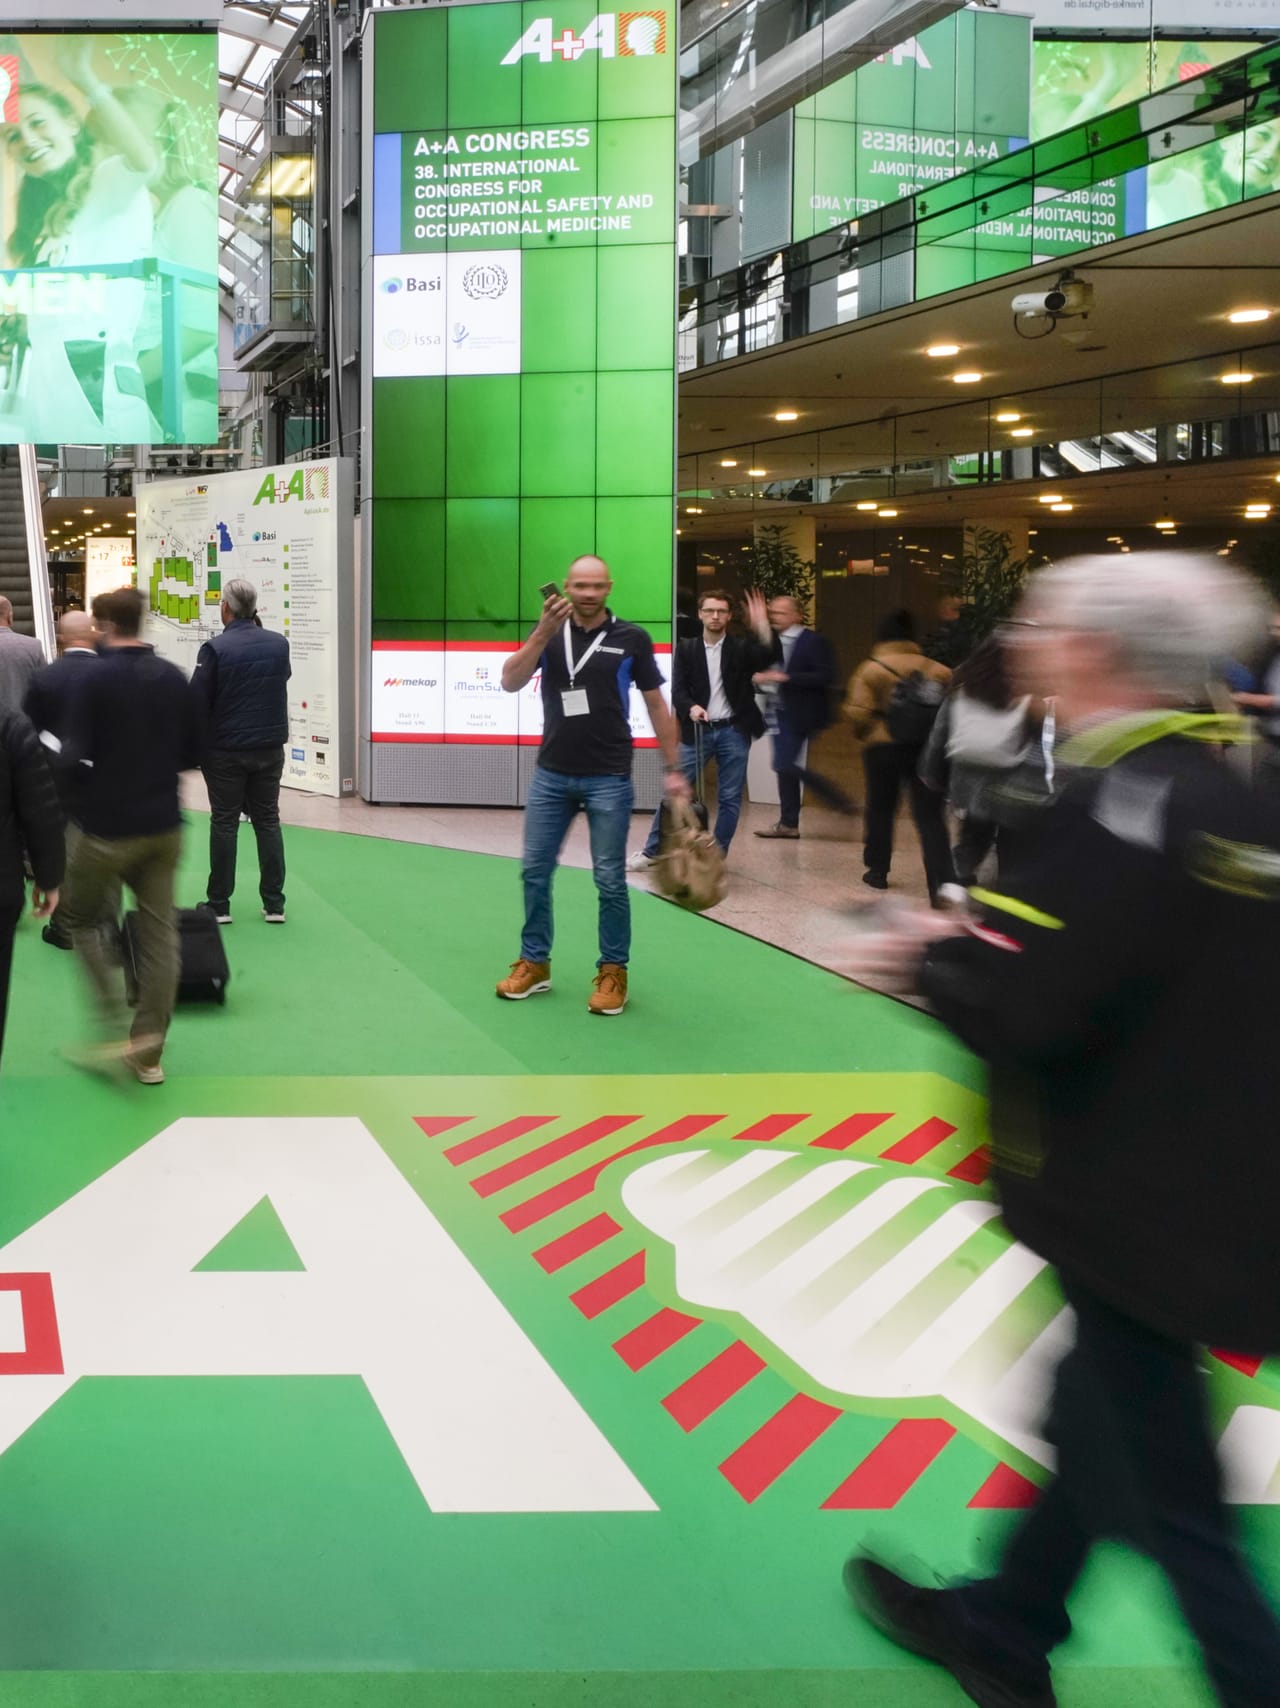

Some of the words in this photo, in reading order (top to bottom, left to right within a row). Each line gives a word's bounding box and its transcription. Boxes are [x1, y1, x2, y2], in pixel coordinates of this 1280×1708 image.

[500, 13, 616, 65] A+A
[414, 136, 460, 156] A+A
[465, 128, 591, 153] CONGRESS
[414, 165, 439, 180] 38.
[443, 157, 580, 178] INTERNATIONAL
[414, 182, 504, 200] CONGRESS
[508, 179, 543, 195] FOR
[414, 200, 543, 219] OCCUPATIONAL
[546, 195, 613, 213] SAFETY
[616, 194, 654, 210] AND
[414, 220, 543, 239] OCCUPATIONAL
[546, 215, 632, 234] MEDICINE
[406, 276, 442, 292] Basi
[413, 333, 441, 346] issa
[252, 469, 305, 506] A+A
[262, 531, 277, 541] Basi
